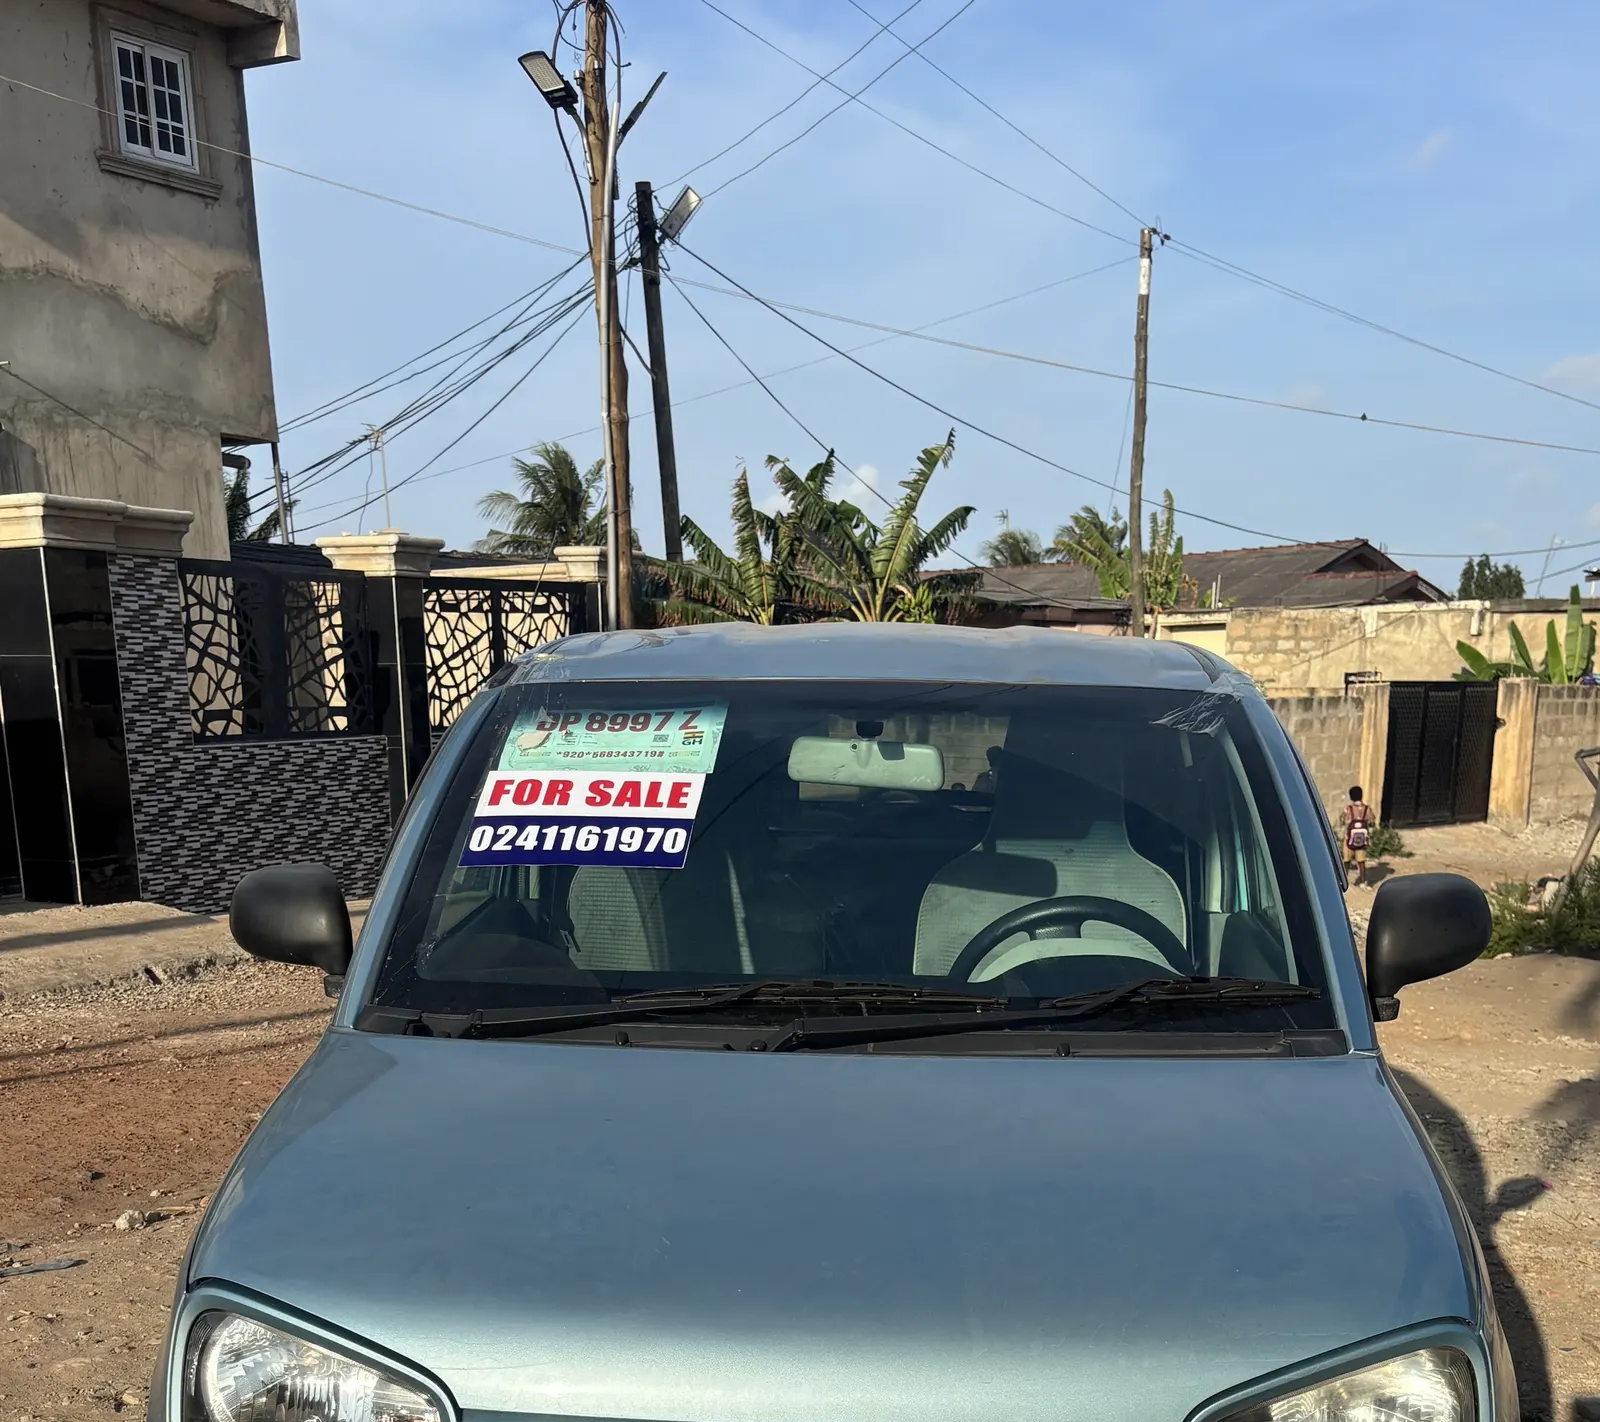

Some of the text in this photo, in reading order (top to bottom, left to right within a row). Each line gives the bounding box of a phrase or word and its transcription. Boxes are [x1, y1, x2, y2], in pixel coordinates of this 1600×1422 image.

[584, 711, 675, 733] 8997
[677, 709, 703, 731] Z
[681, 738, 704, 746] GH
[487, 778, 692, 808] FOR SALE
[468, 825, 688, 854] 0241161970
